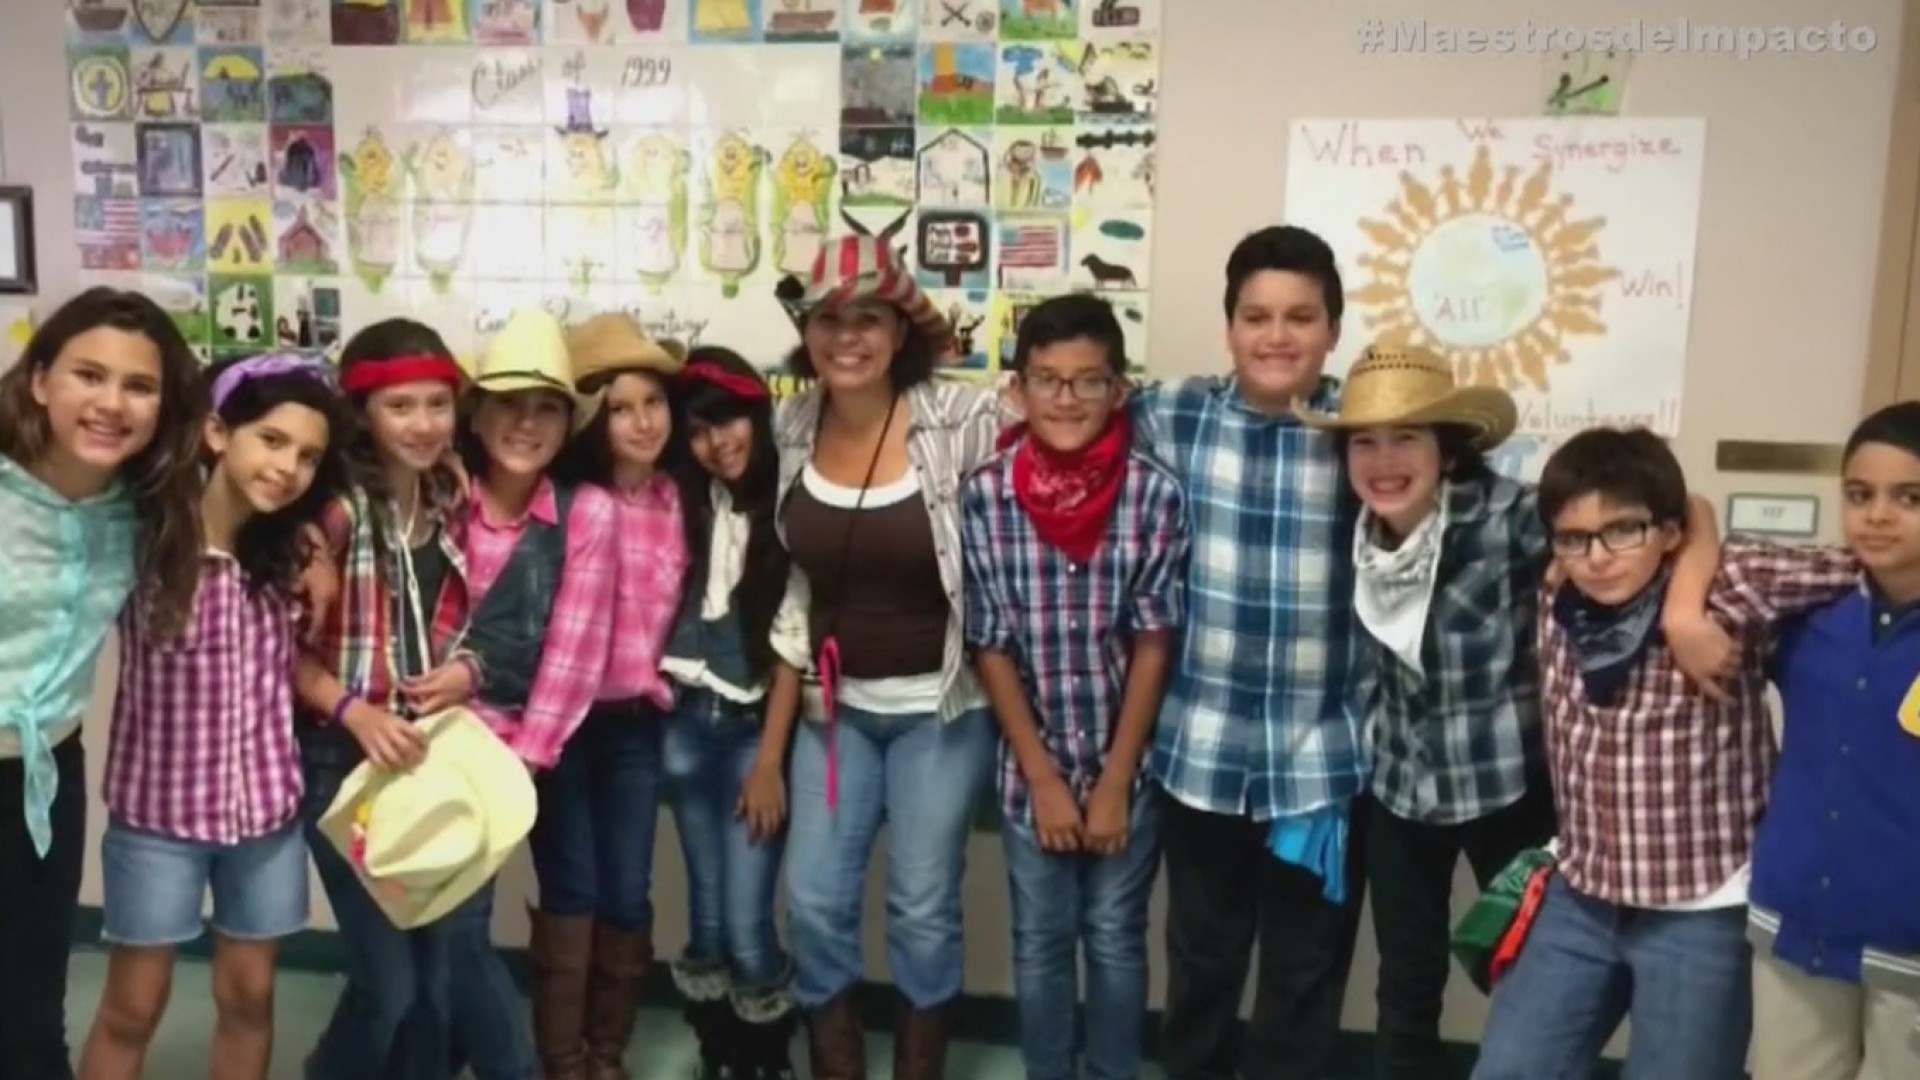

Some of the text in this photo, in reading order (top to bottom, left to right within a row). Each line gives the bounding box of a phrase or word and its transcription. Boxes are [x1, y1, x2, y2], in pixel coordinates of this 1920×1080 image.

[621, 56, 672, 88] 1999
[1301, 118, 1683, 173] When We Synergize
